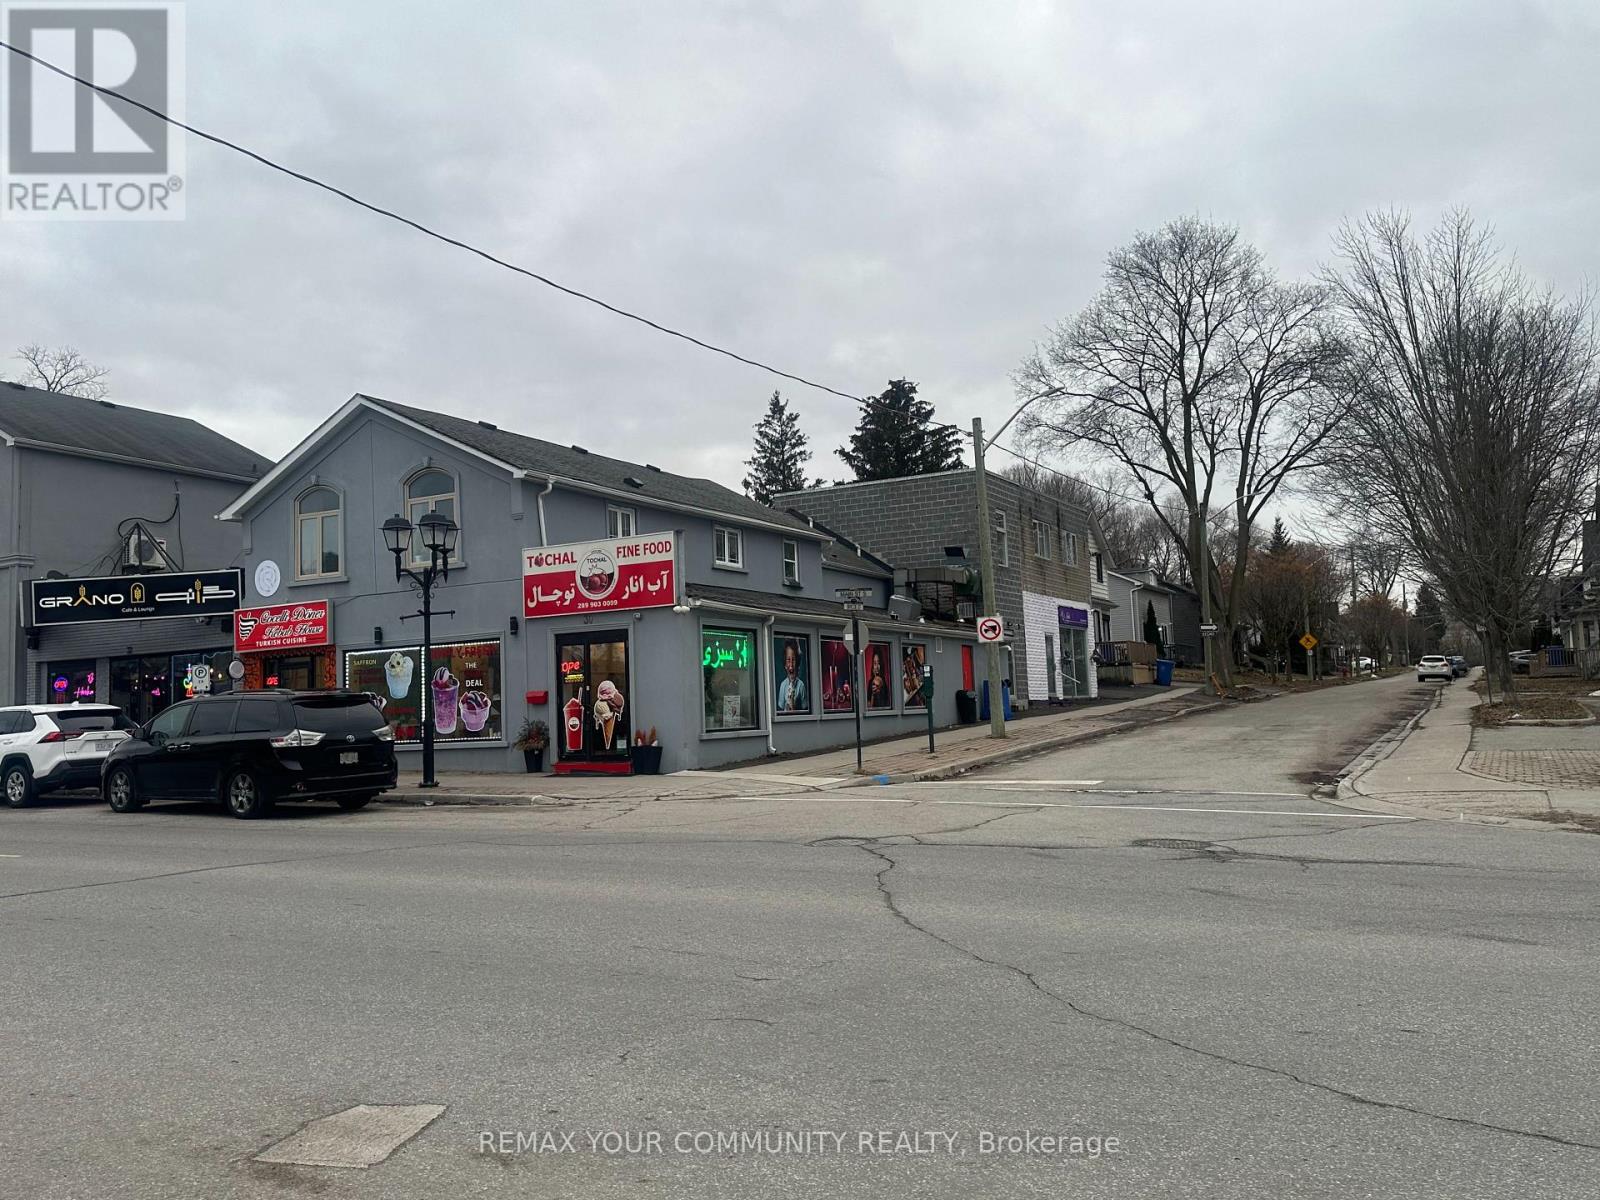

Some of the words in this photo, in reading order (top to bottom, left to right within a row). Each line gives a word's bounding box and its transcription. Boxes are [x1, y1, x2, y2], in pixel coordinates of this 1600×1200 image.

[616, 544, 641, 559] FINE
[643, 541, 672, 556] FOOD
[621, 575, 644, 600] انار
[647, 569, 670, 596] آب
[39, 584, 125, 608] GRANO
[527, 583, 576, 608] توچال
[255, 639, 281, 648] TURKISH
[282, 636, 307, 645] CUISINE
[465, 679, 484, 687] DEAL
